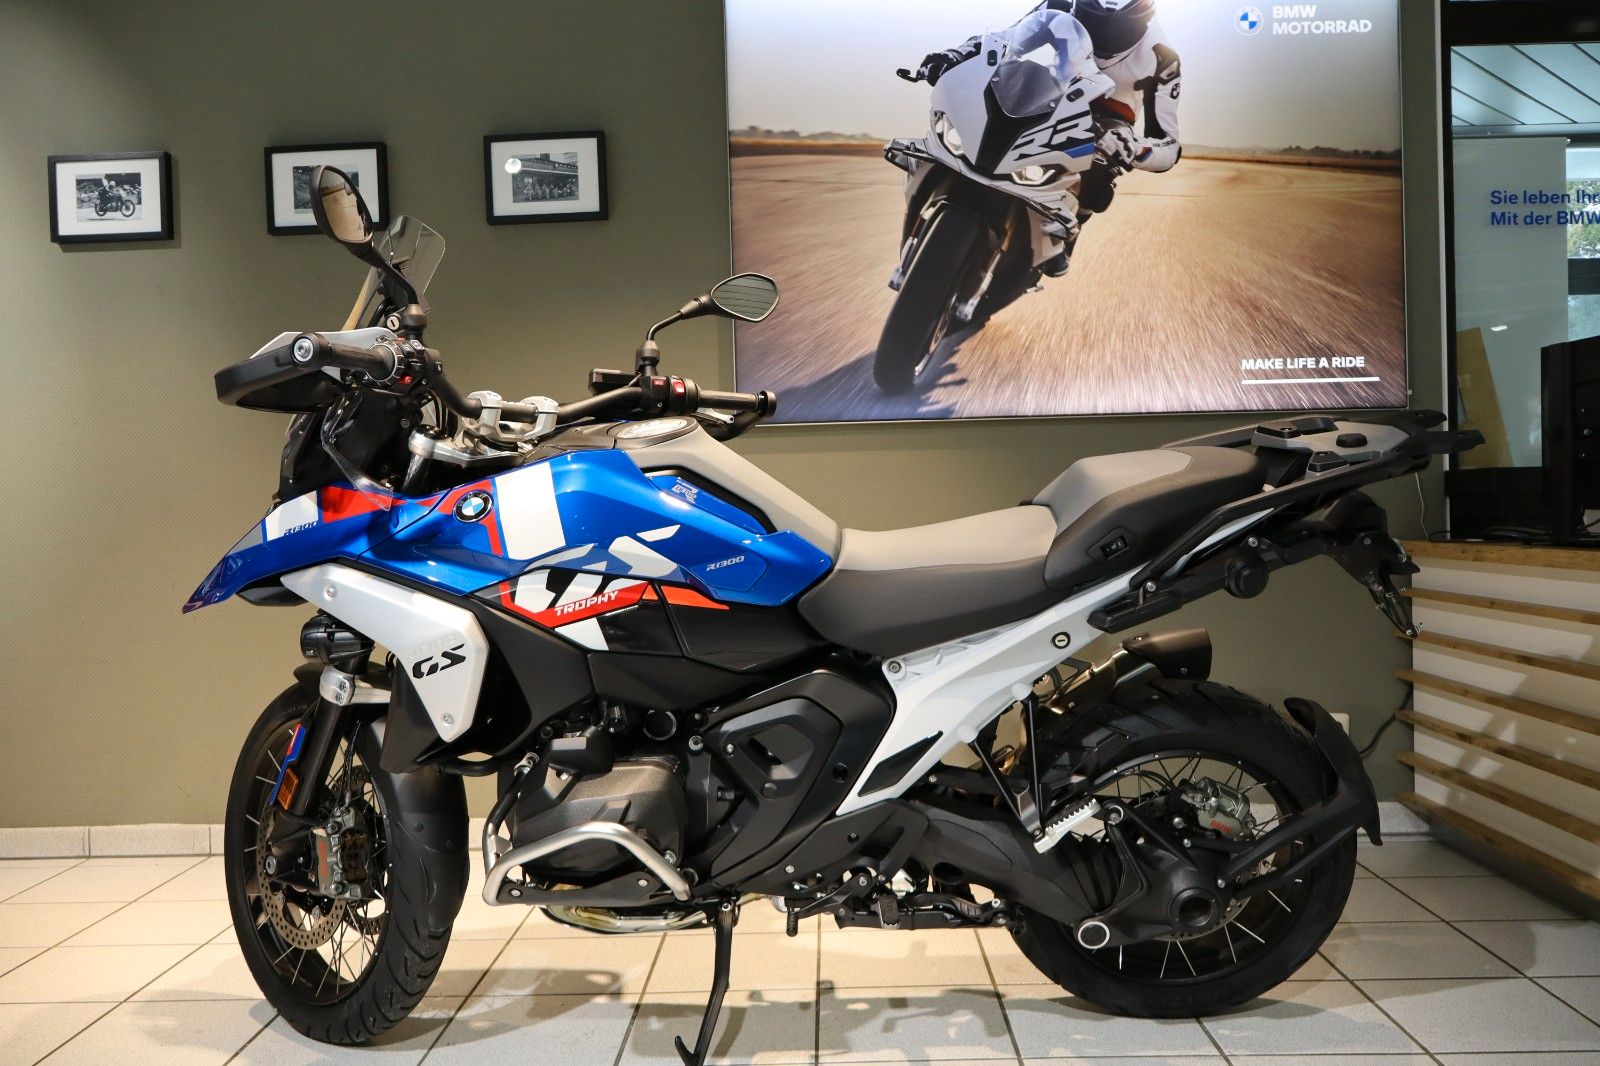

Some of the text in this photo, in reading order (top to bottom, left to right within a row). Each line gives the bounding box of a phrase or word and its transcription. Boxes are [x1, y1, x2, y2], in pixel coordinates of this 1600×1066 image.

[1272, 4, 1317, 19] BMW
[1272, 19, 1372, 35] MOTORRAD
[1490, 190, 1519, 205] Sie
[1523, 189, 1571, 205] leben
[1490, 210, 1600, 226] Mit der BMW
[1241, 356, 1365, 370] MAKE LIFE A RIDE
[554, 590, 619, 616] TROPHY
[412, 642, 467, 680] GS
